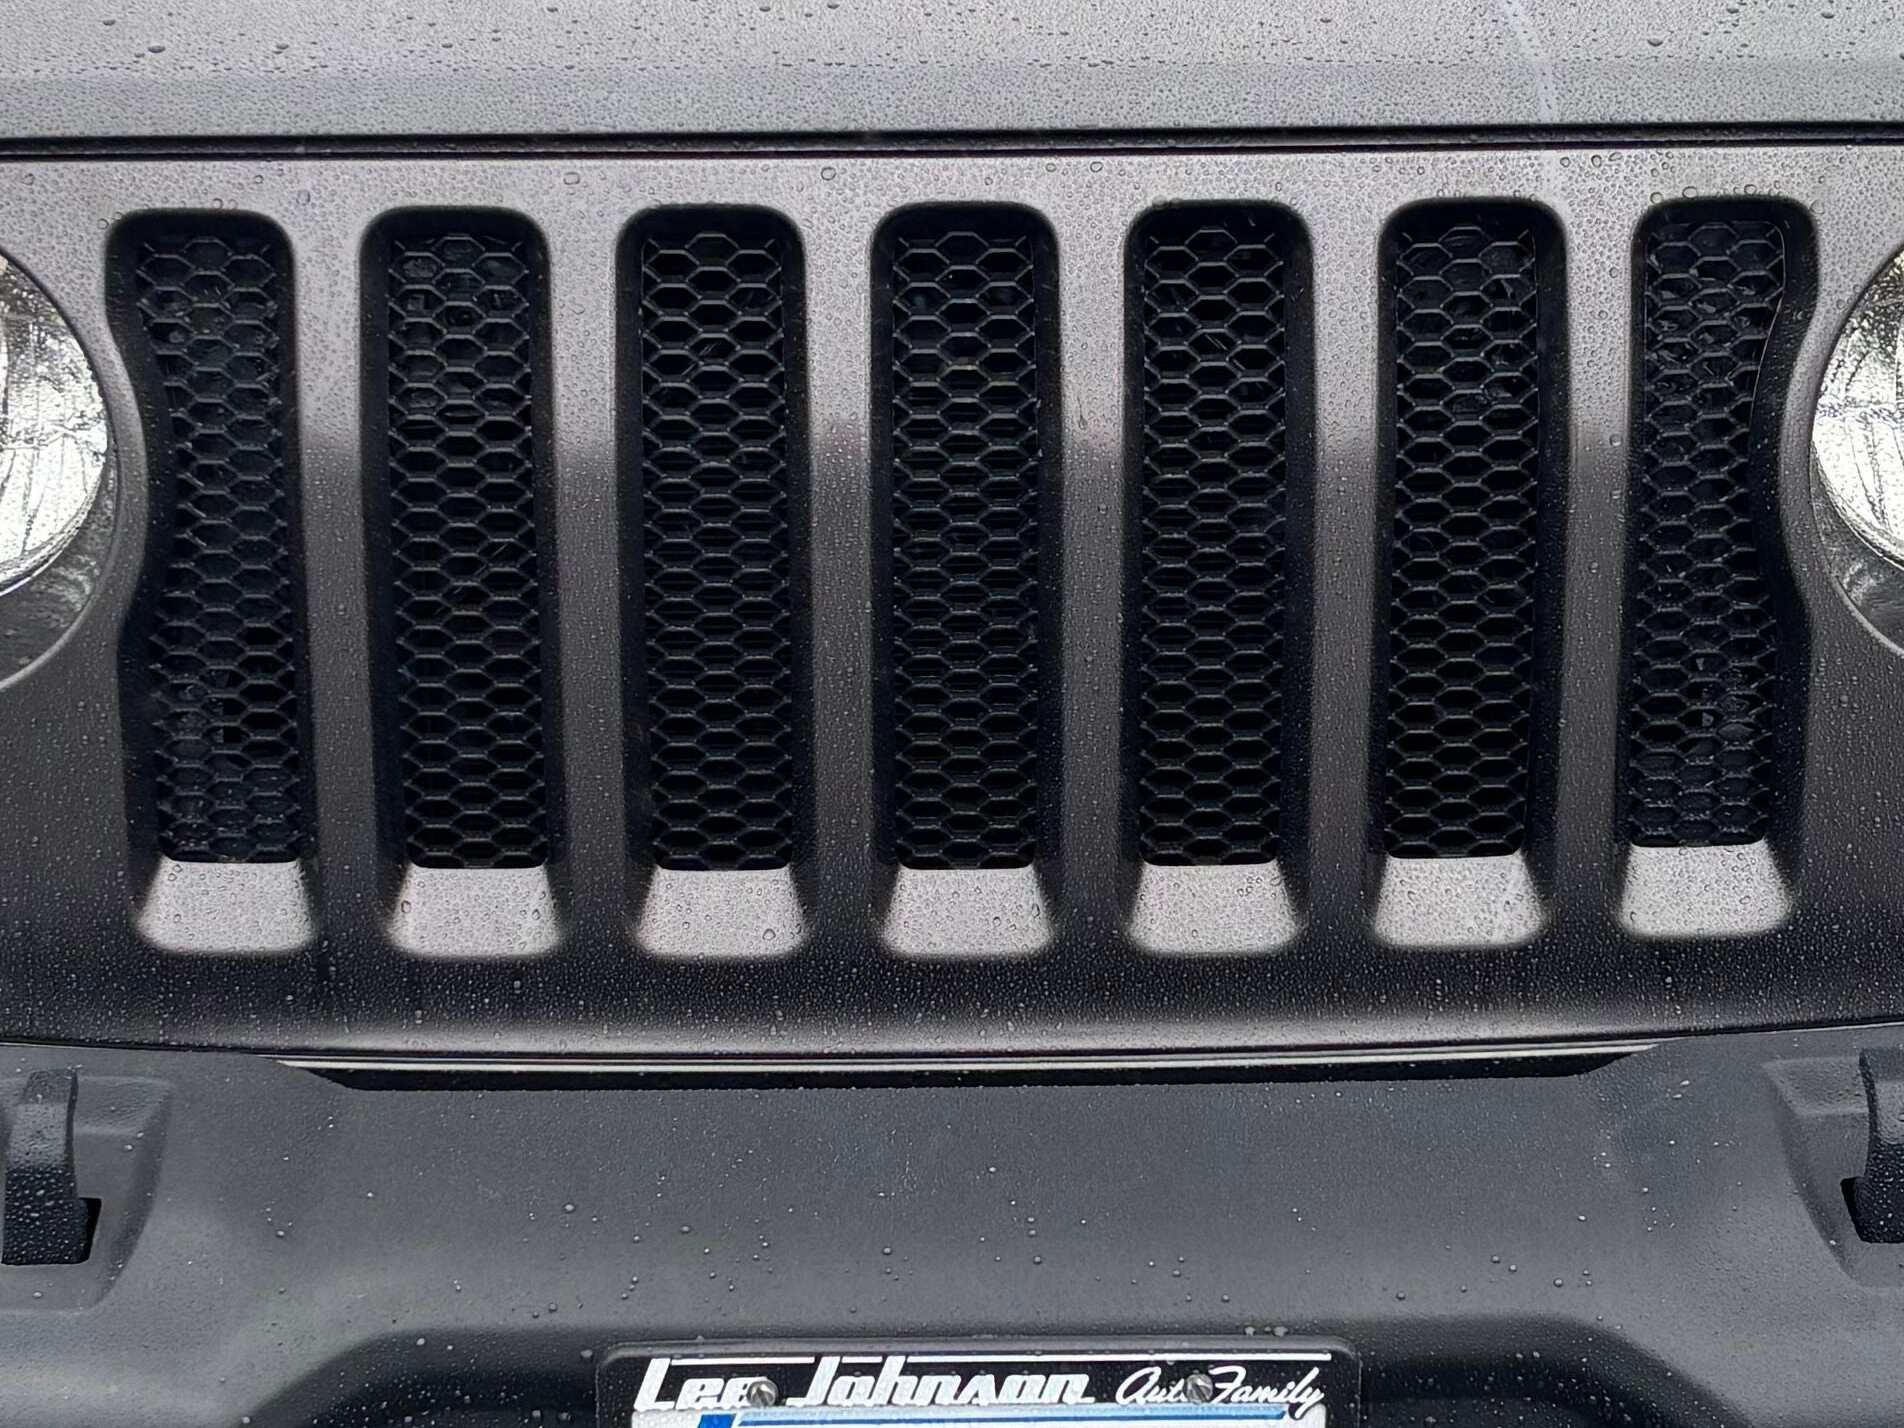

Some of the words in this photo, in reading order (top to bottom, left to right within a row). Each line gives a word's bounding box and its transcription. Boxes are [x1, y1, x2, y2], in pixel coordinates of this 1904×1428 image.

[786, 1355, 1096, 1407] Johnson
[1115, 1366, 1201, 1405] Aut
[1207, 1365, 1325, 1421] Family
